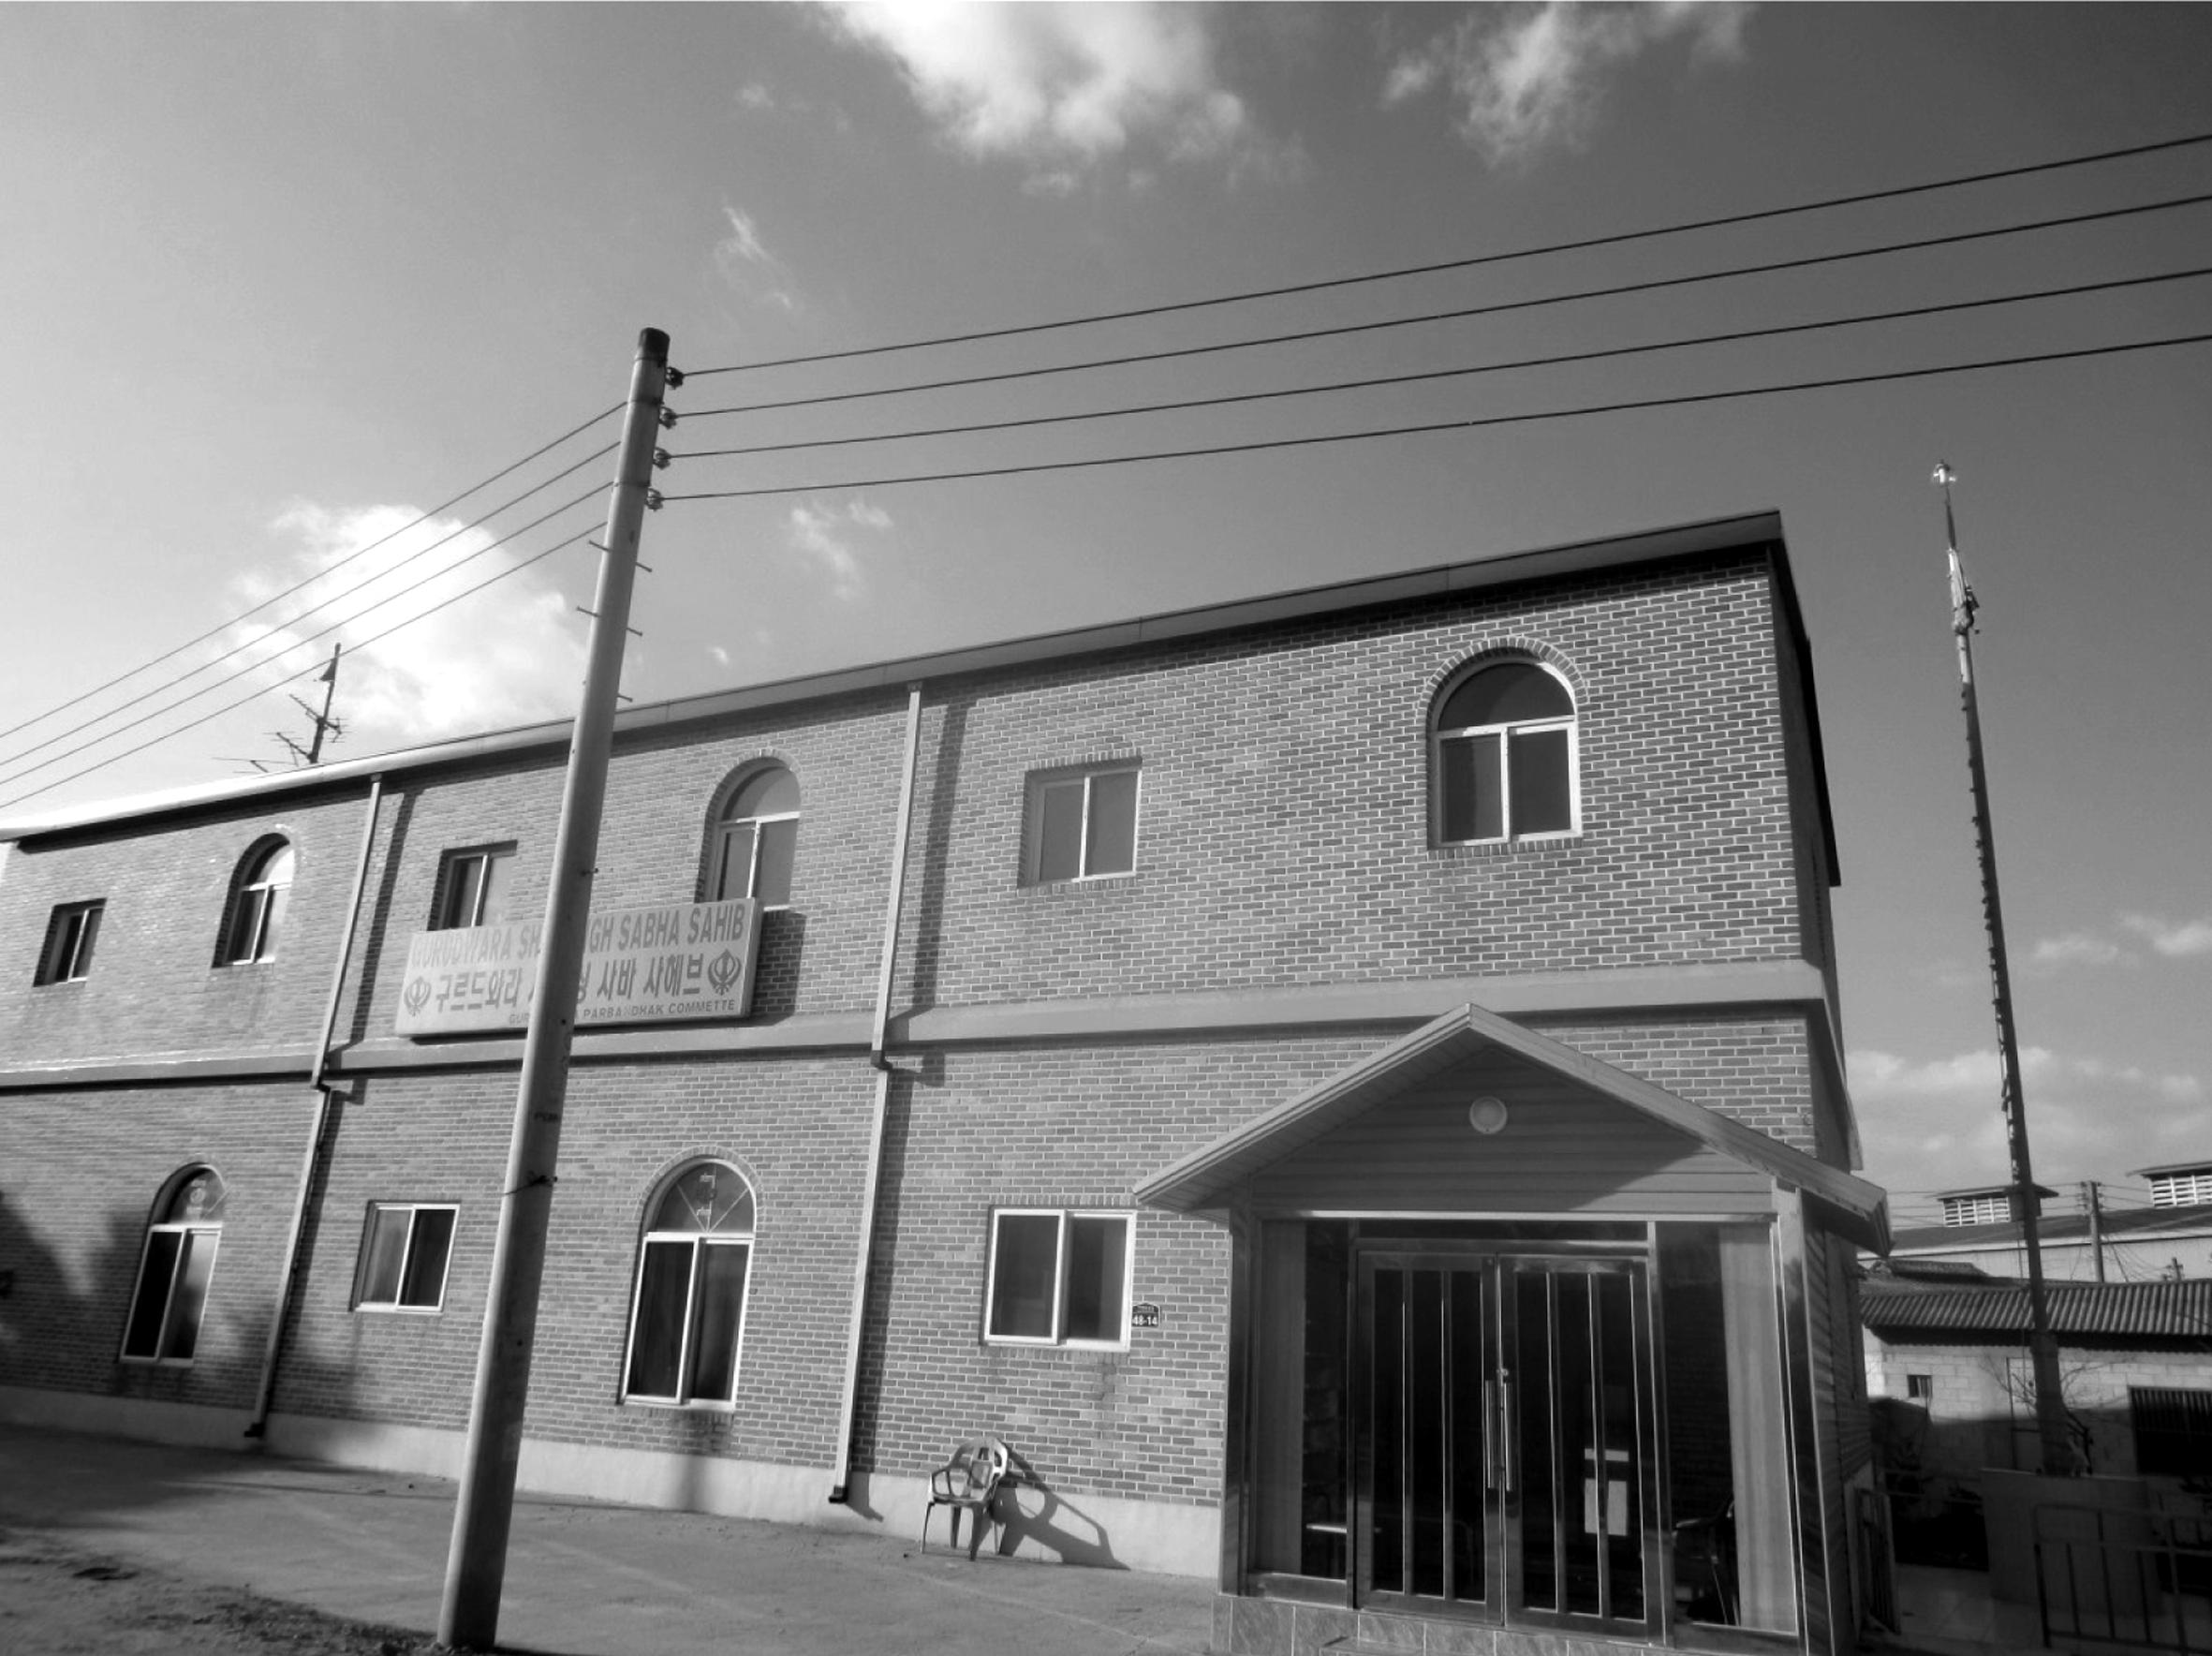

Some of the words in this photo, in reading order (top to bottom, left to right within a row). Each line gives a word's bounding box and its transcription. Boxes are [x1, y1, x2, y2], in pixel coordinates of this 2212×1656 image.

[411, 926, 512, 968] GURUDWARA
[618, 909, 680, 952] SABHA
[686, 902, 746, 945] SAHIB
[435, 967, 524, 1014] 구르드와라
[596, 956, 638, 1001] 사바
[668, 998, 736, 1014] COMMETTE
